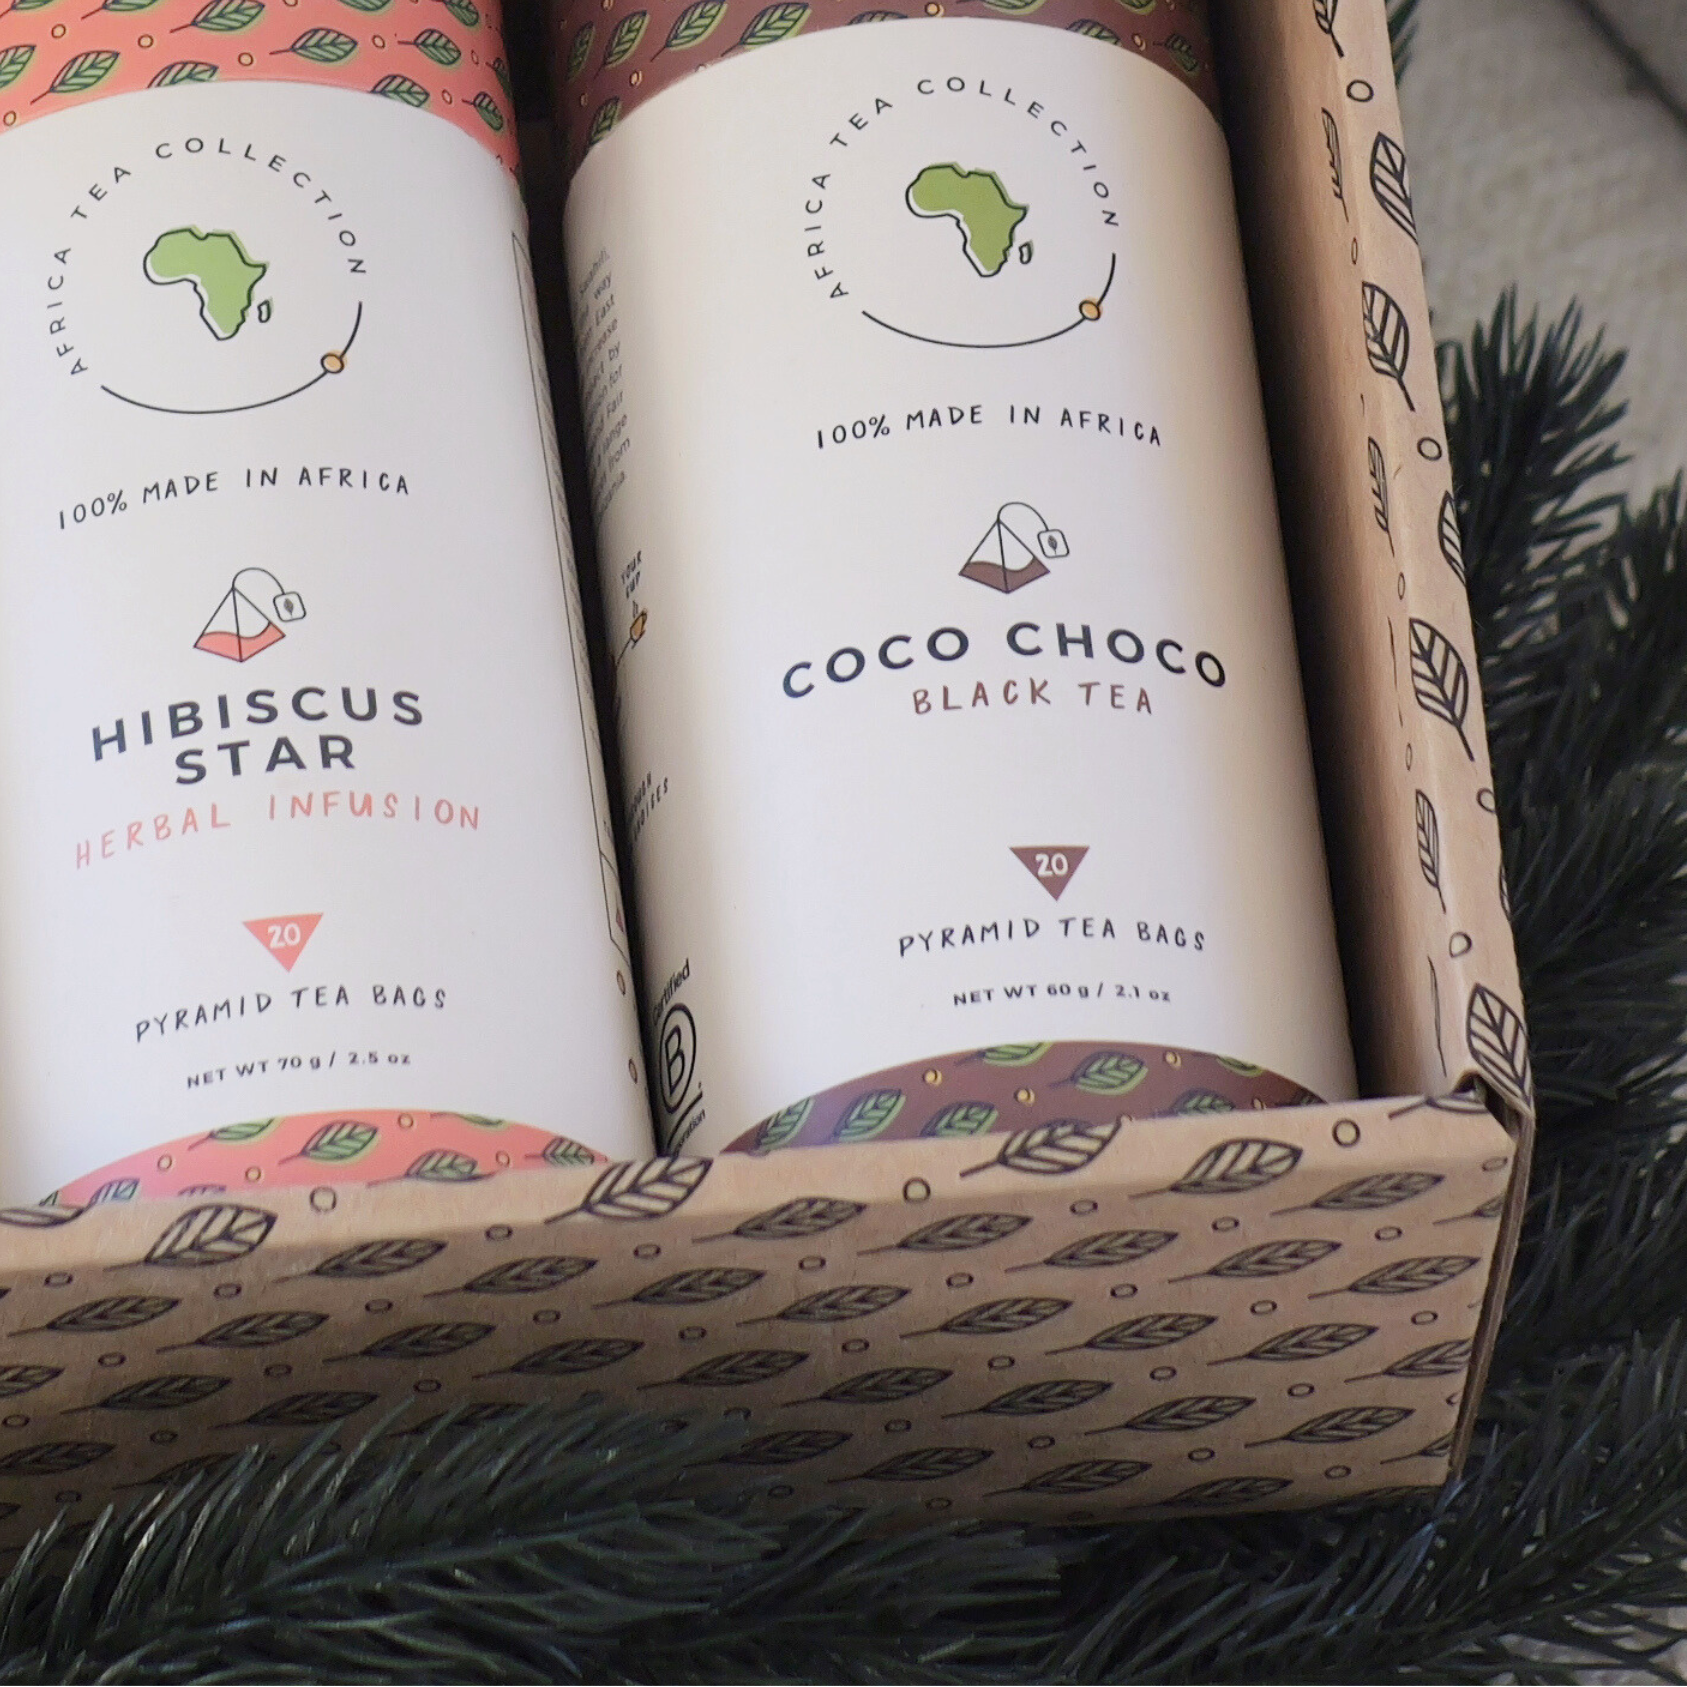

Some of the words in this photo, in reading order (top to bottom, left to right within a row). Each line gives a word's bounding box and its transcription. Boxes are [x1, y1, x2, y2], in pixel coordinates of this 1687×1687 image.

[804, 173, 850, 299] AFRICA
[829, 97, 893, 147] TEA
[916, 76, 1119, 227] COLLECTION
[46, 247, 89, 376] AFRICA
[70, 166, 132, 219] TEA
[155, 137, 367, 274] COLLECTION
[817, 413, 891, 450] 100%
[906, 404, 982, 431] MADE
[1009, 404, 1041, 425] IN
[1060, 408, 1161, 447] AFRICA
[59, 489, 128, 530] 100%
[142, 471, 218, 504] MADE
[246, 466, 278, 488] IN
[298, 466, 409, 495] AFRICA
[782, 626, 970, 699] COCO
[1006, 621, 1226, 688] CHOCO
[912, 677, 1051, 715] BLACK
[1077, 681, 1152, 715] TEA
[92, 686, 423, 762] HIBISCUS
[175, 734, 355, 785] STAR
[76, 802, 232, 870] HERBAL
[269, 790, 479, 831] INFUSION
[1035, 853, 1069, 878] 20
[267, 923, 301, 949] 20
[899, 918, 1040, 958] PYRAMID
[1058, 917, 1116, 939] TEA
[1136, 921, 1205, 951] BAGS
[135, 993, 272, 1043] PYRAMID
[291, 985, 349, 1009] TEA
[372, 985, 446, 1009] BAGS
[953, 989, 992, 1006] NET
[1003, 985, 1036, 999] WT
[1148, 990, 1171, 1002] oz
[187, 1068, 225, 1089] NET
[235, 1061, 267, 1078] WT
[387, 1054, 410, 1065] oz
